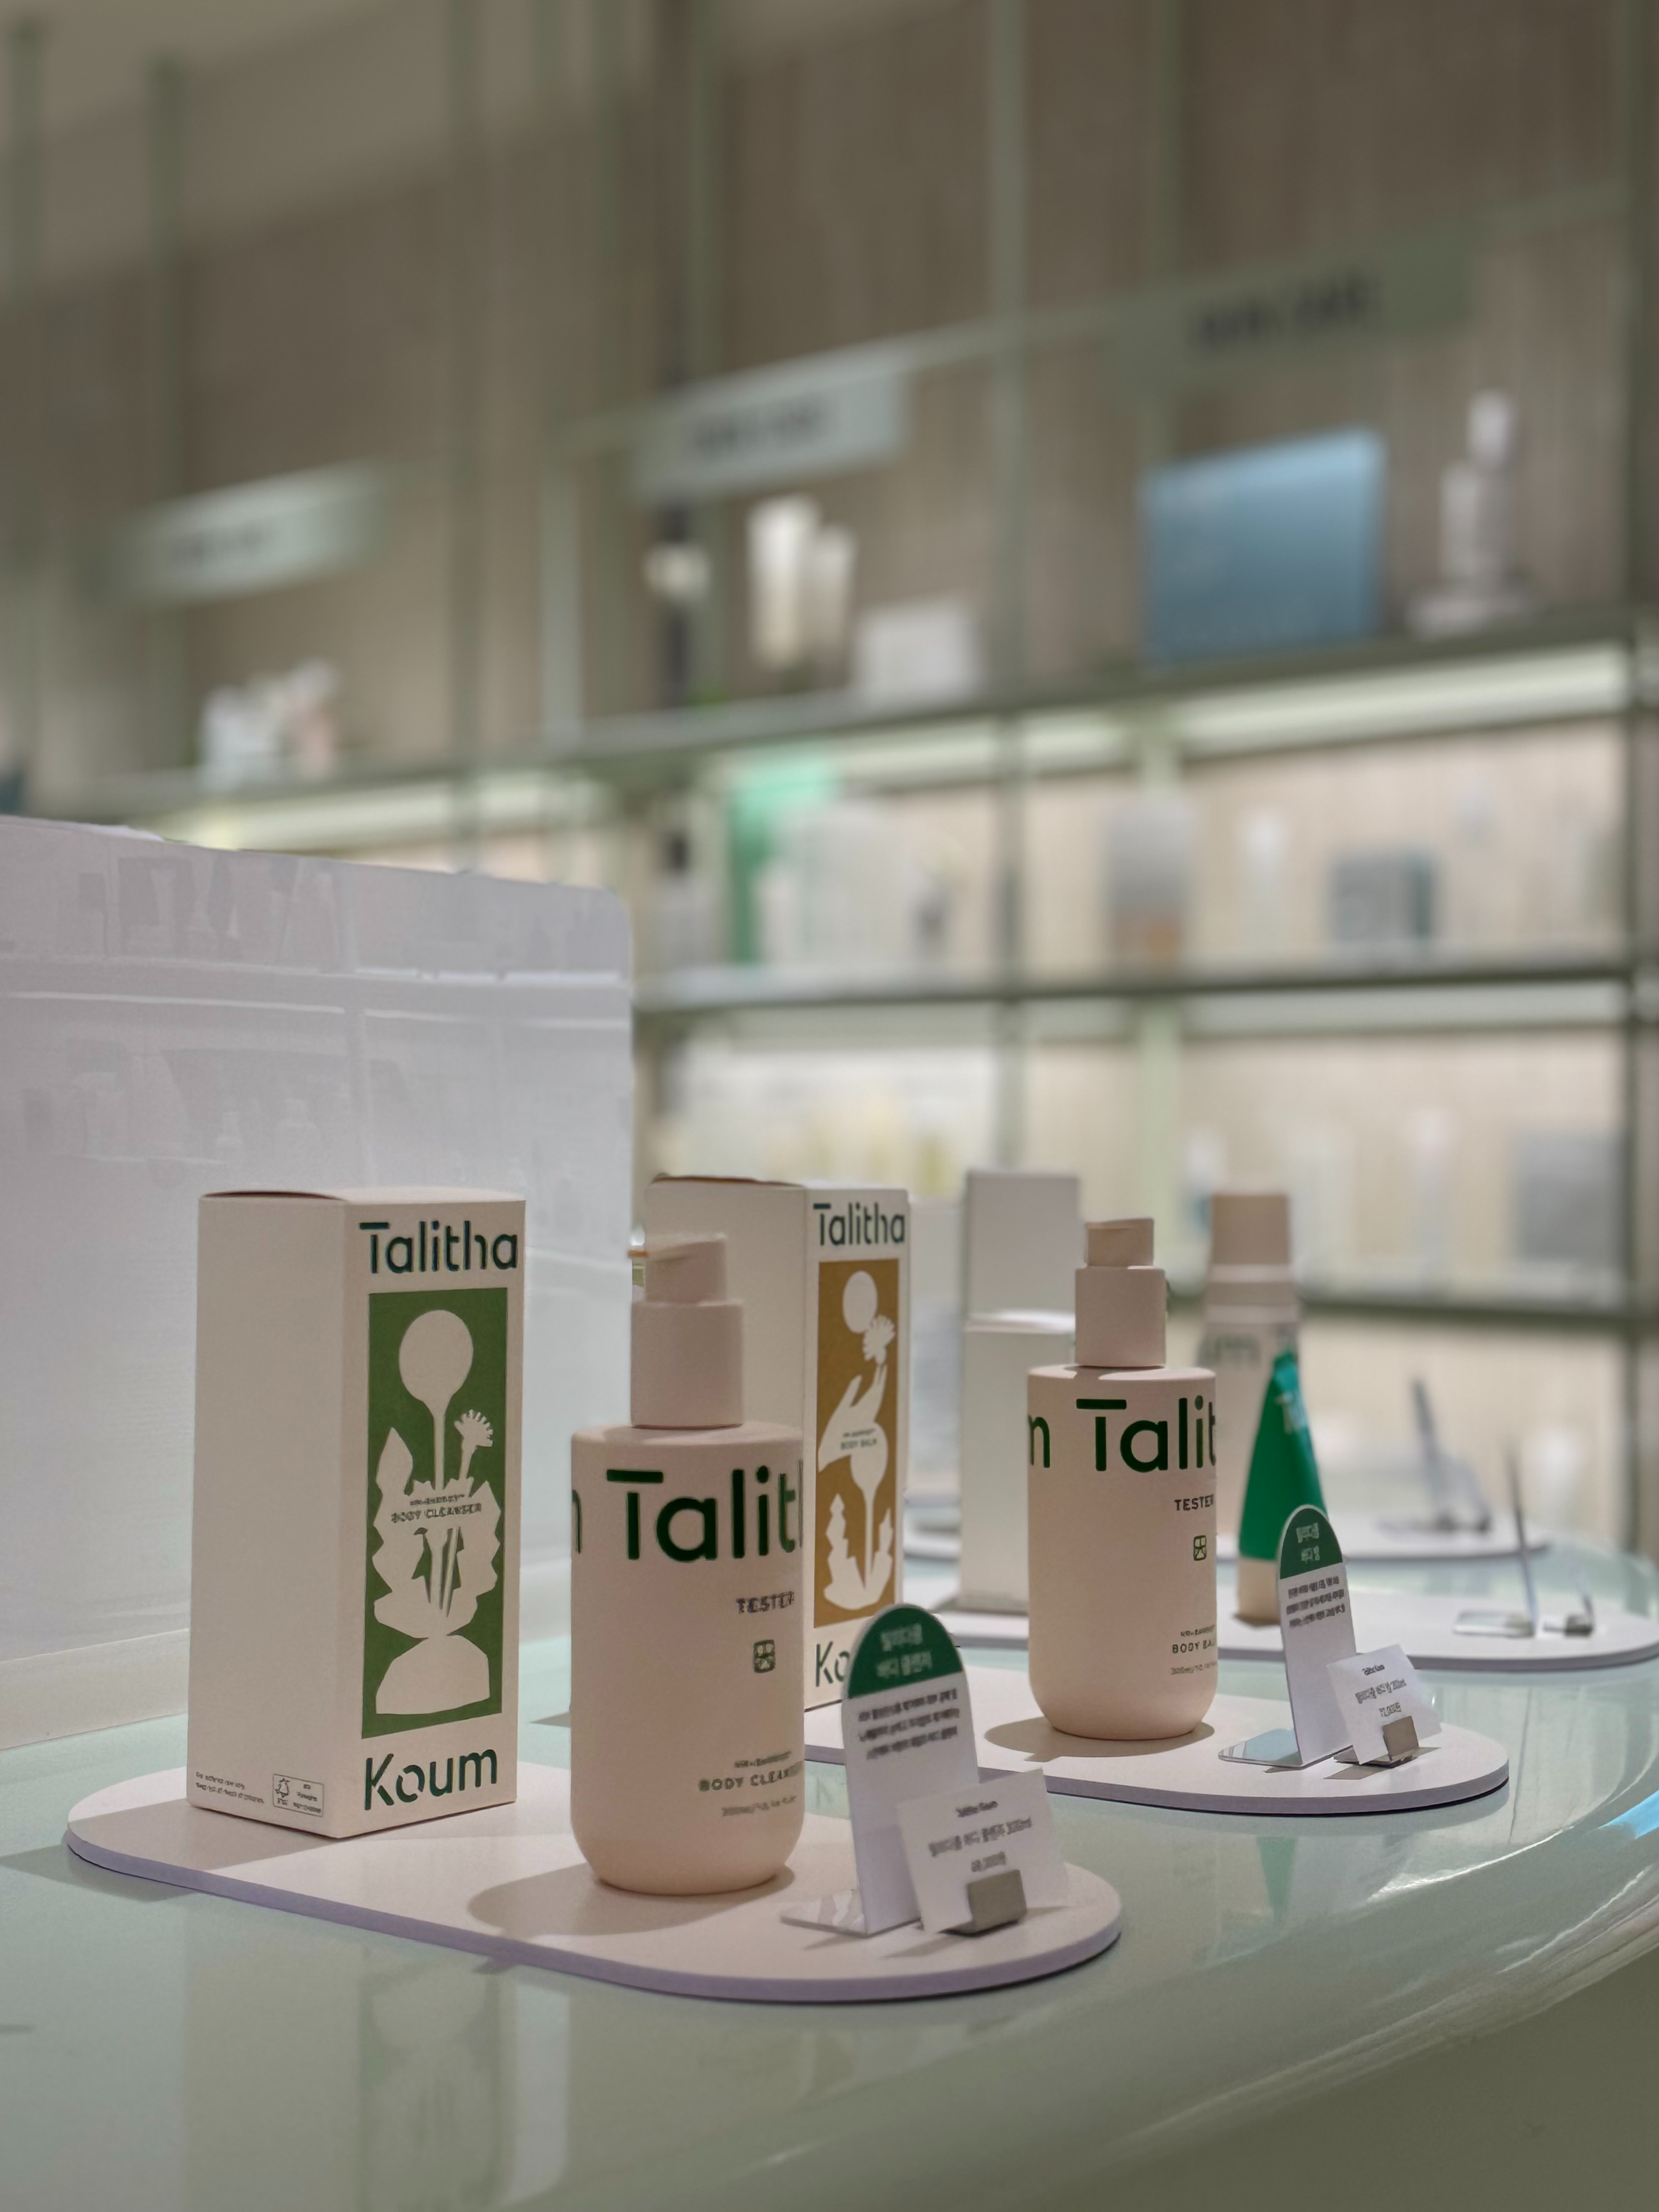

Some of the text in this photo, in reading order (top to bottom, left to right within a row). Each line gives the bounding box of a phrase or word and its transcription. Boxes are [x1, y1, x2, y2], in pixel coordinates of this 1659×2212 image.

[359, 1220, 518, 1274] Talitha
[813, 1202, 905, 1246] Talitha
[606, 1459, 803, 1563] Talit
[814, 1641, 850, 1688] Ko
[1172, 1642, 1200, 1653] BODY
[364, 1749, 497, 1810] Koum
[698, 1778, 743, 1791] BODY
